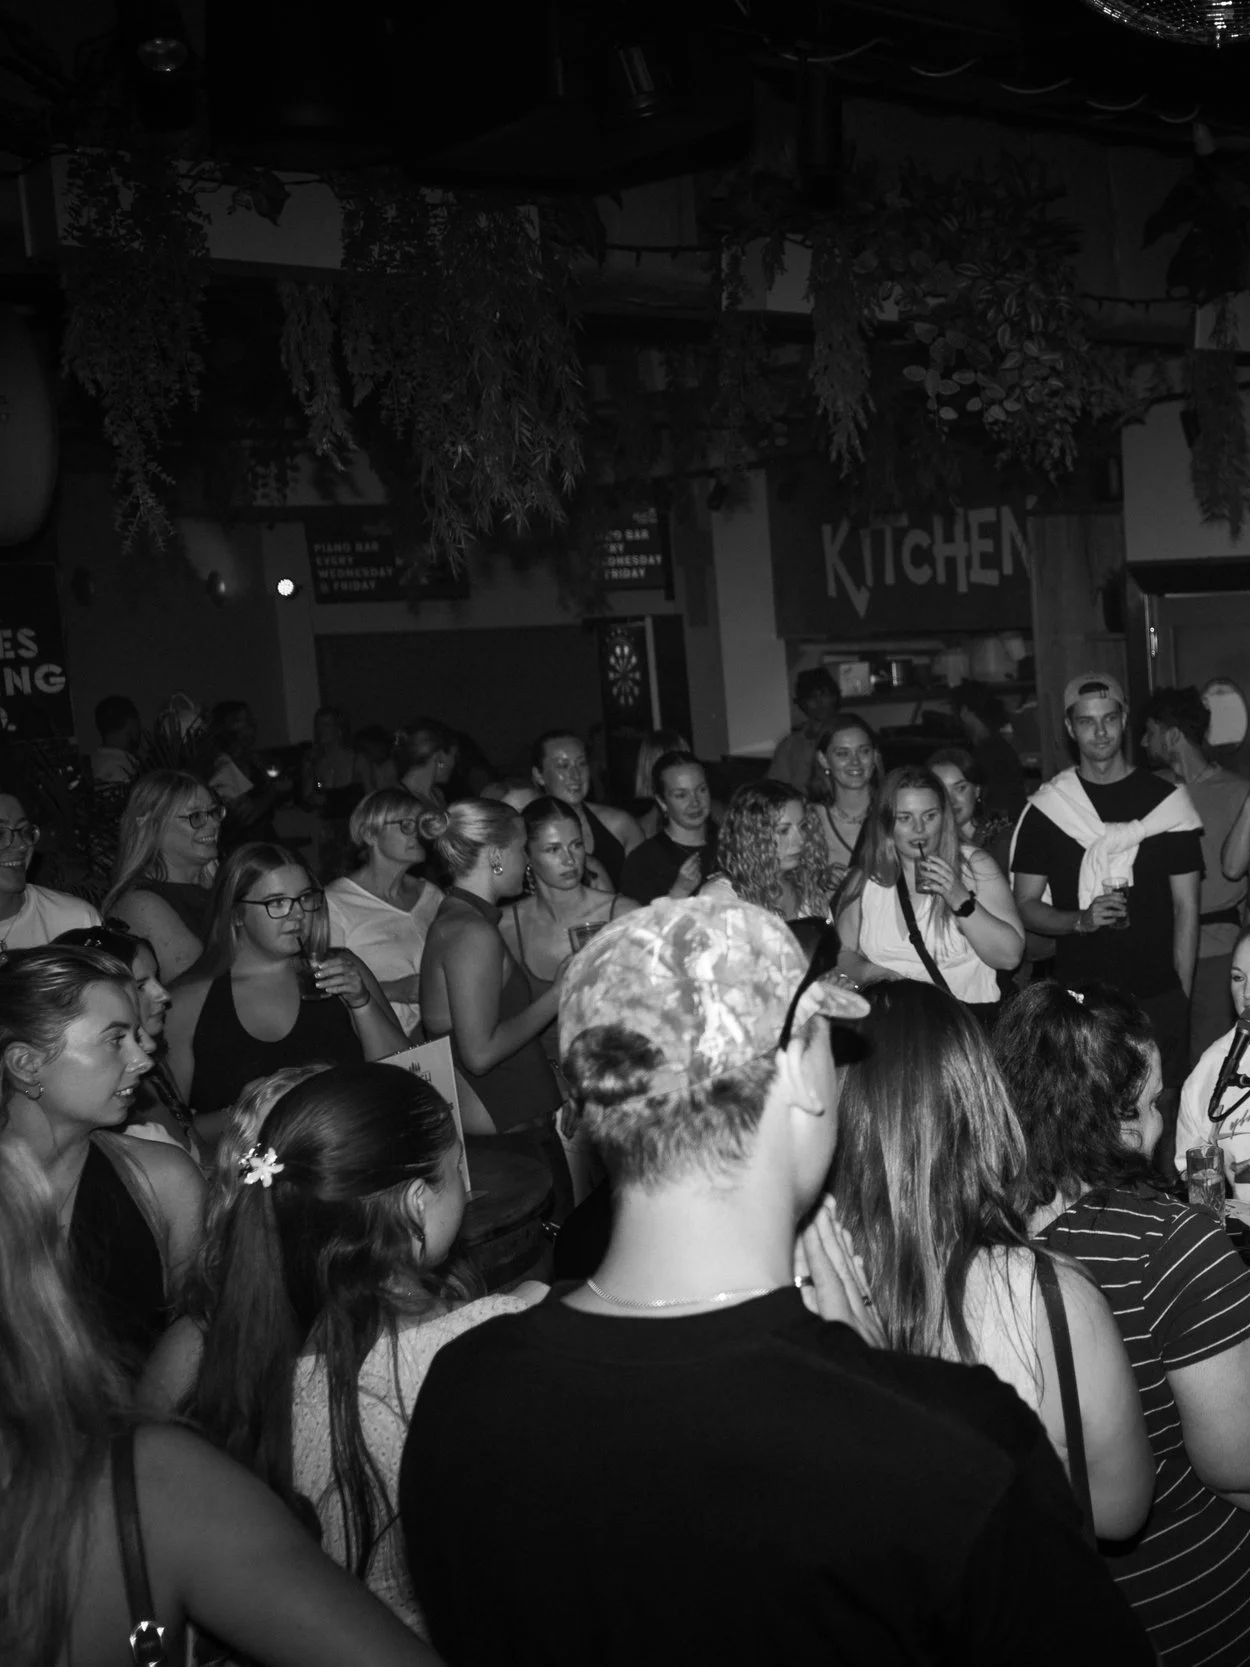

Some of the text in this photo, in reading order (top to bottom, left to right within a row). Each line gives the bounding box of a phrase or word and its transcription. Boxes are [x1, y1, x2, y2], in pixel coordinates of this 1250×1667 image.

[313, 541, 380, 553] PIANO BAR
[317, 567, 394, 579] WEDNESDAY
[333, 579, 377, 592] FRIDAY
